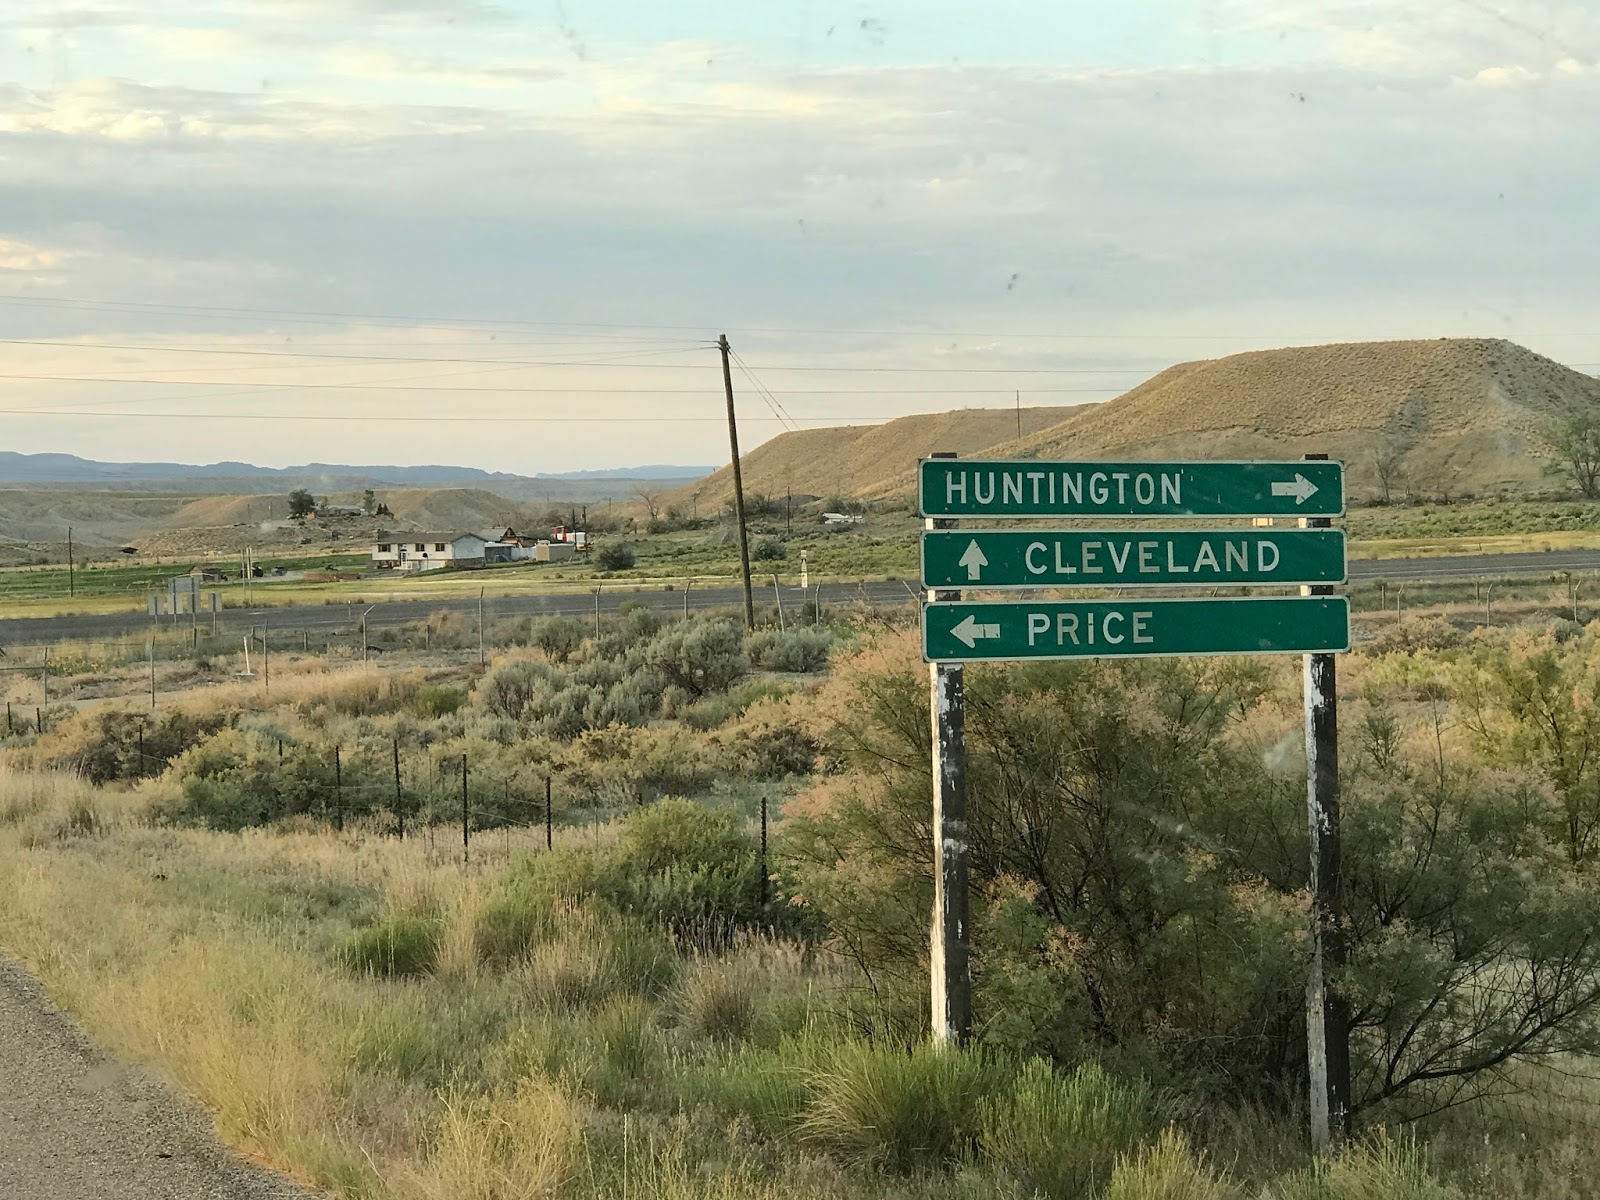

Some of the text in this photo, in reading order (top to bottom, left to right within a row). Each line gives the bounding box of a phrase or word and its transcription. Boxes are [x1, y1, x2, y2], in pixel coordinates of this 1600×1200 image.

[946, 471, 1182, 505] HUNTINGTON
[1025, 541, 1280, 574] CLEVELAND
[1027, 611, 1154, 646] PRICE
